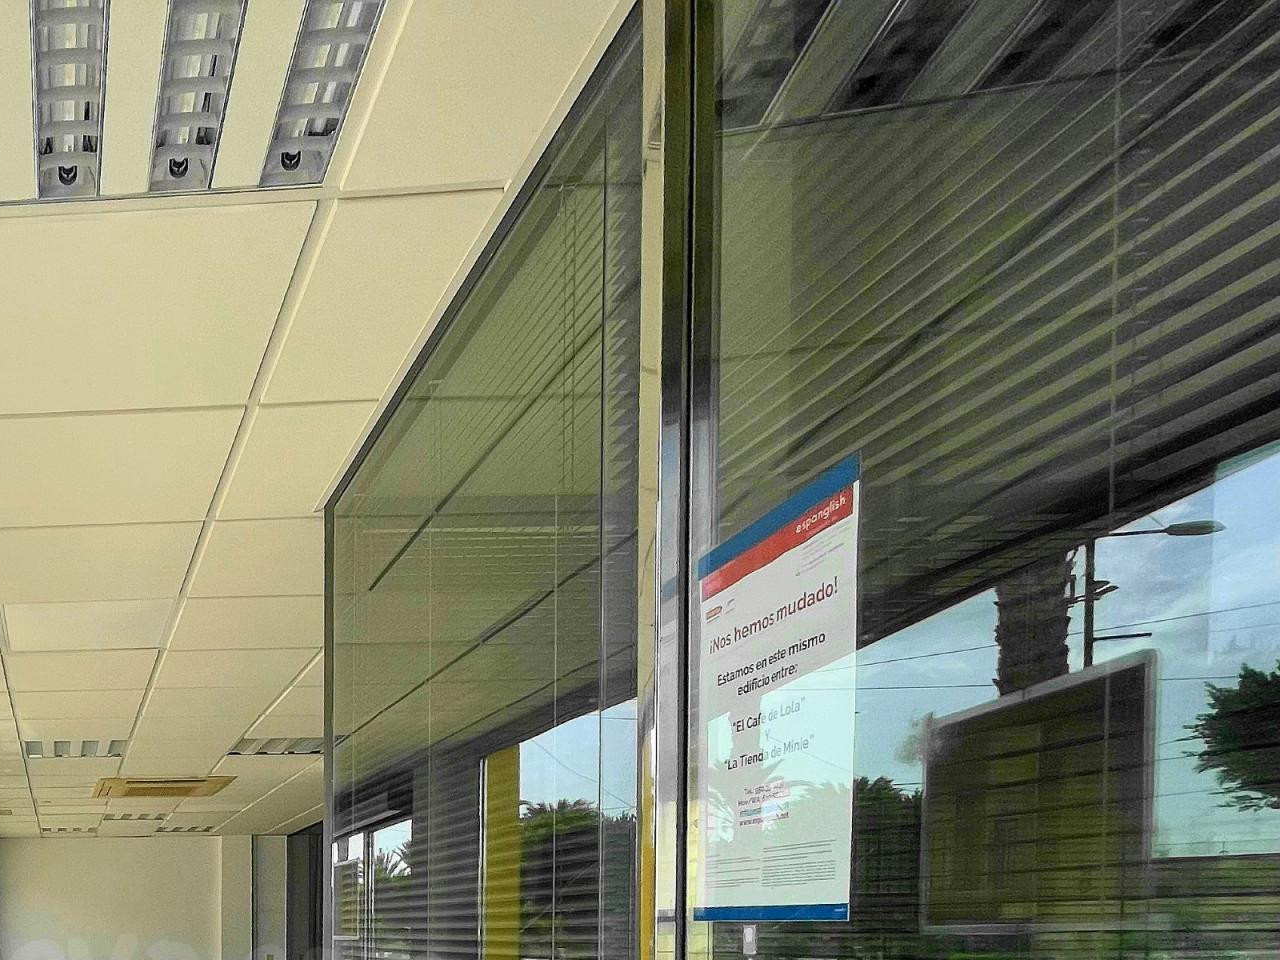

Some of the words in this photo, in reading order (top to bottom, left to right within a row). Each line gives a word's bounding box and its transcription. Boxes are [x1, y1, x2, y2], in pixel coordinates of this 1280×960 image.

[795, 495, 846, 533] espanglish
[734, 613, 774, 642] hemos
[776, 576, 837, 621] mudado!
[717, 662, 754, 686] Estamos
[756, 657, 767, 671] en
[768, 648, 786, 665] este
[788, 633, 825, 656] mismo
[738, 674, 770, 696] edificio
[771, 663, 798, 683] entre:
[768, 708, 778, 721] de
[740, 748, 769, 767] Tienda
[770, 745, 781, 758] de
